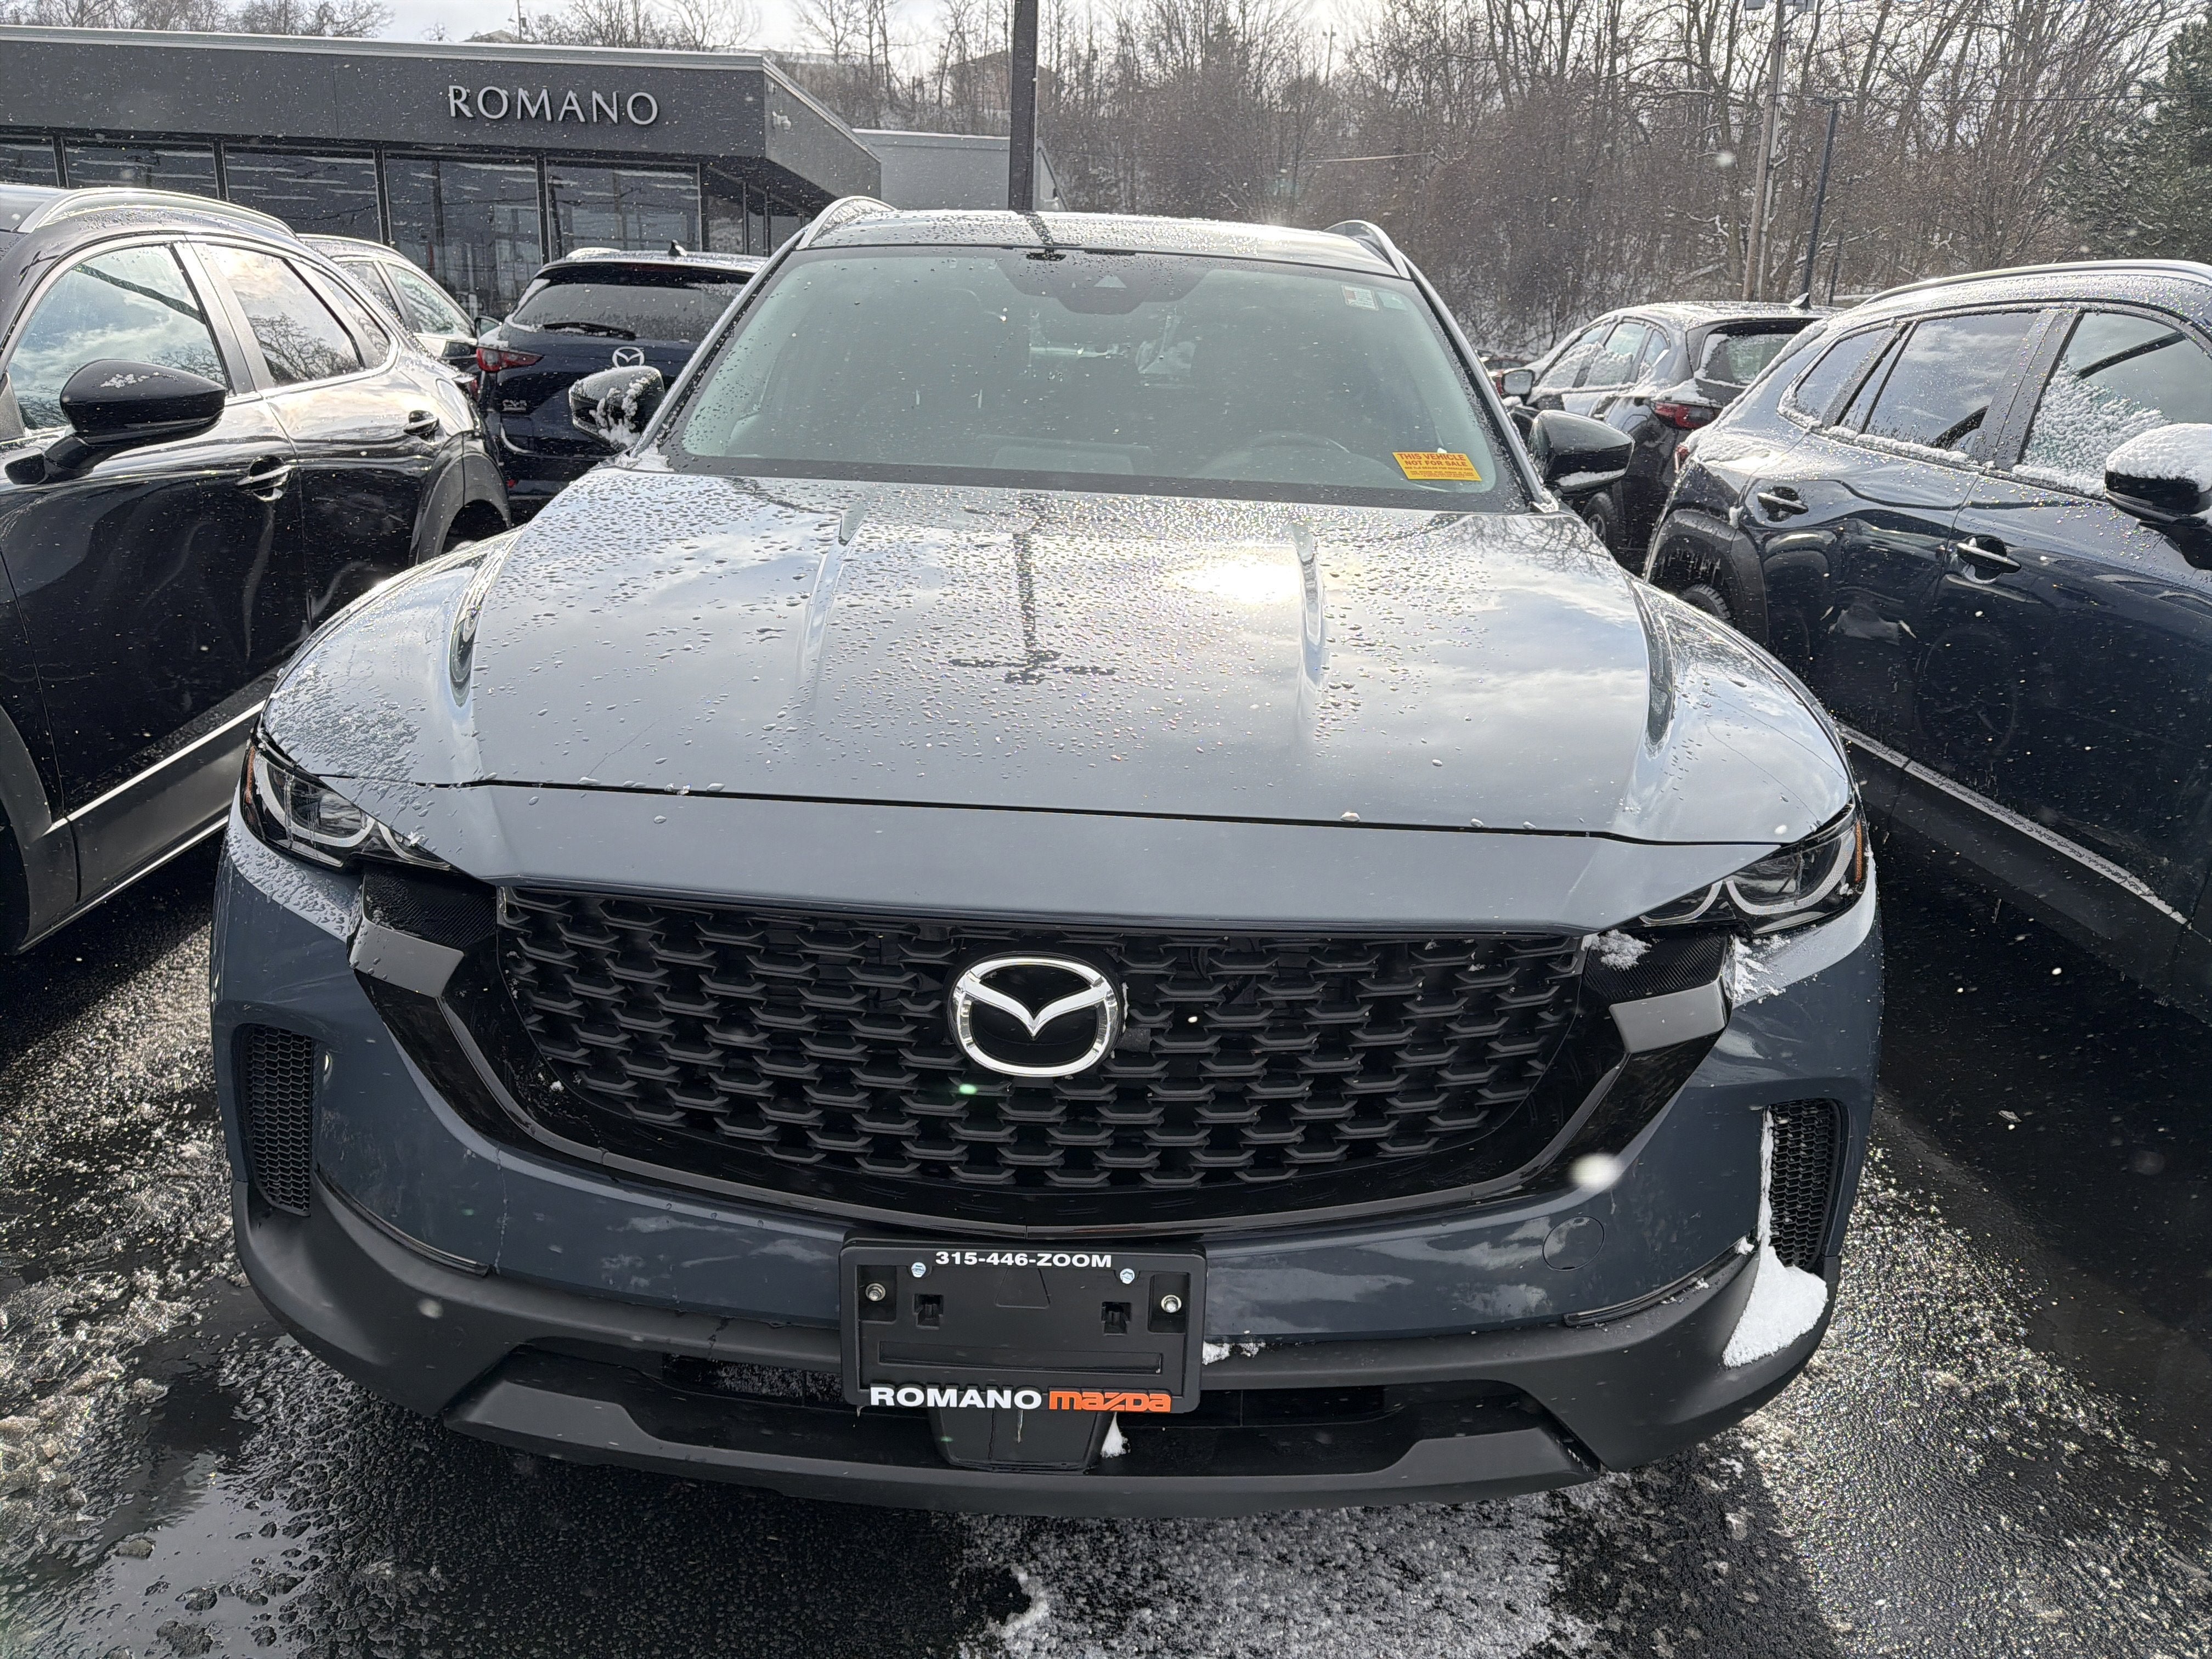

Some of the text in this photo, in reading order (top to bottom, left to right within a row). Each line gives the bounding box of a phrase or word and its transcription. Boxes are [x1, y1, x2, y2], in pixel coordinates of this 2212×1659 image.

[448, 85, 659, 126] ROMANO
[935, 1251, 1113, 1268] 315-446-ZOOM
[870, 1386, 1042, 1410] ROMANO
